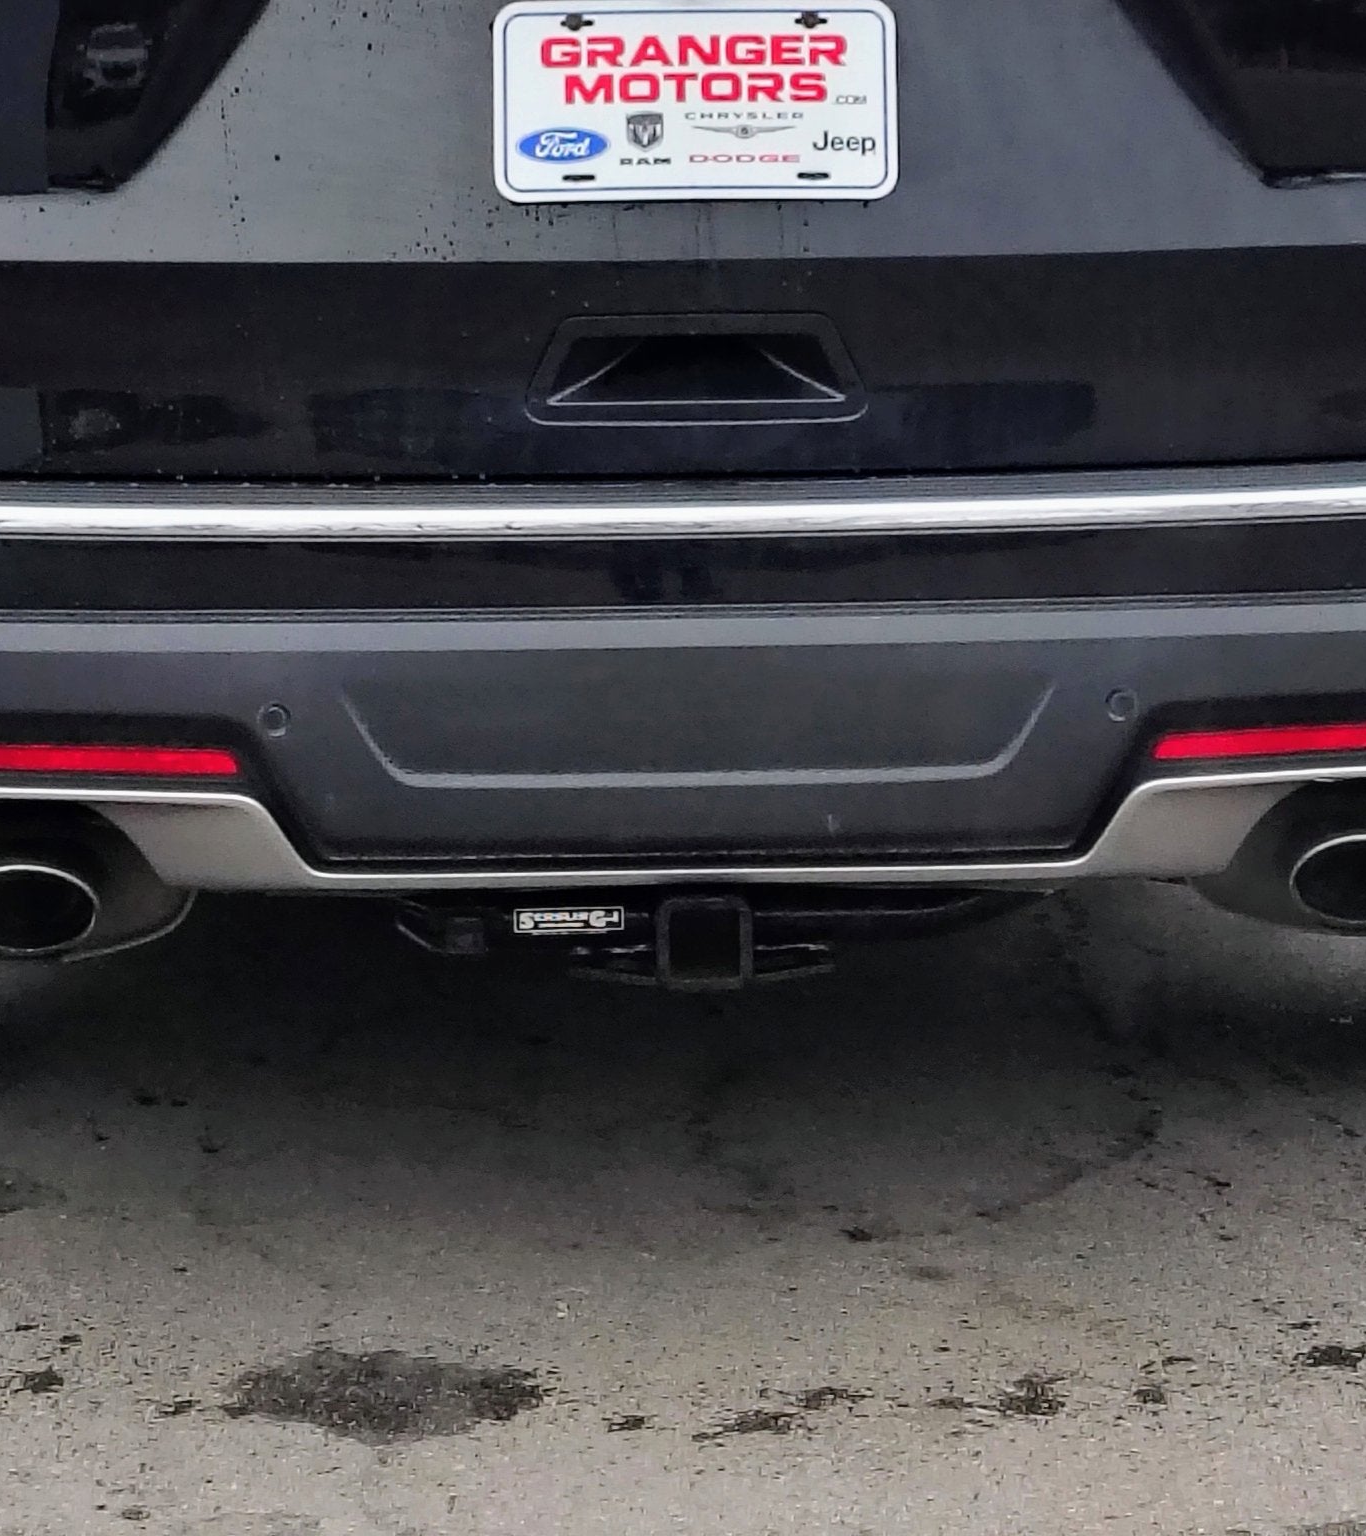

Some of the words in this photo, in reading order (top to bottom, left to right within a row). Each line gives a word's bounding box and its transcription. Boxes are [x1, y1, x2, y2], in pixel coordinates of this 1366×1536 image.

[540, 35, 848, 68] GRANGER
[564, 72, 829, 105] MOTORS
[685, 112, 804, 121] CHRYSLER
[534, 131, 591, 158] Ford
[813, 130, 876, 156] Jeep
[619, 157, 672, 166] RAM
[689, 154, 801, 163] DODGE
